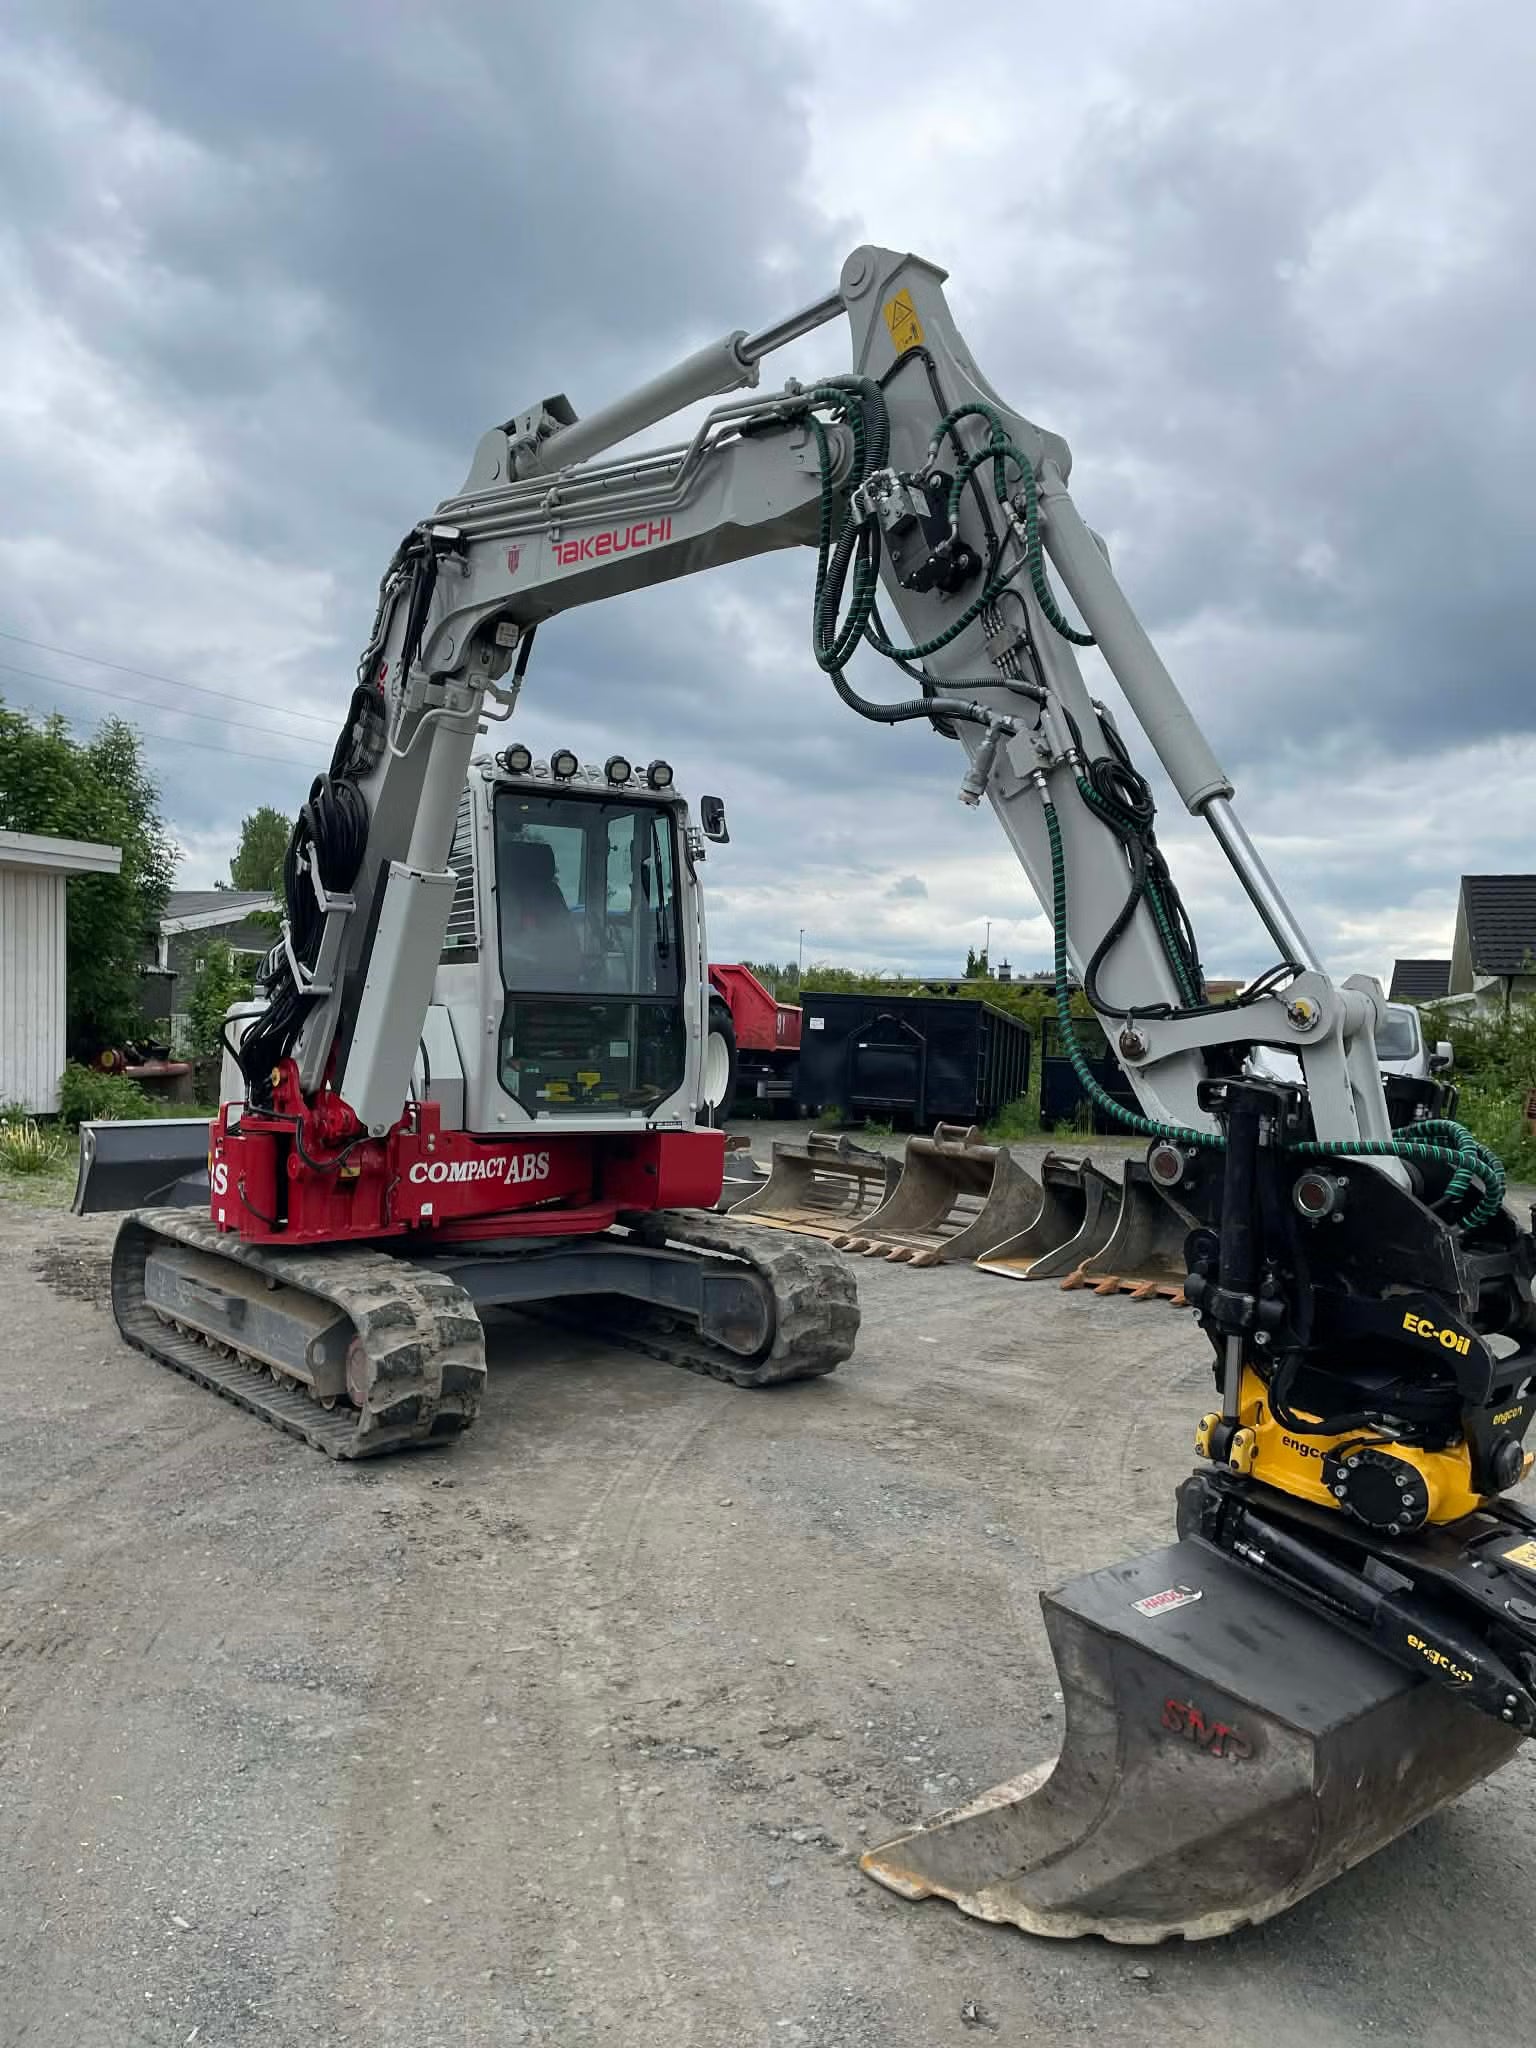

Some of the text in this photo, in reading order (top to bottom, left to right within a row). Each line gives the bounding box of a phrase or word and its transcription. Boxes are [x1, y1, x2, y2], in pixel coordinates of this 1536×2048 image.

[409, 1151, 550, 1185] COMPACT ABS
[1402, 1311, 1471, 1356] EC-Oil
